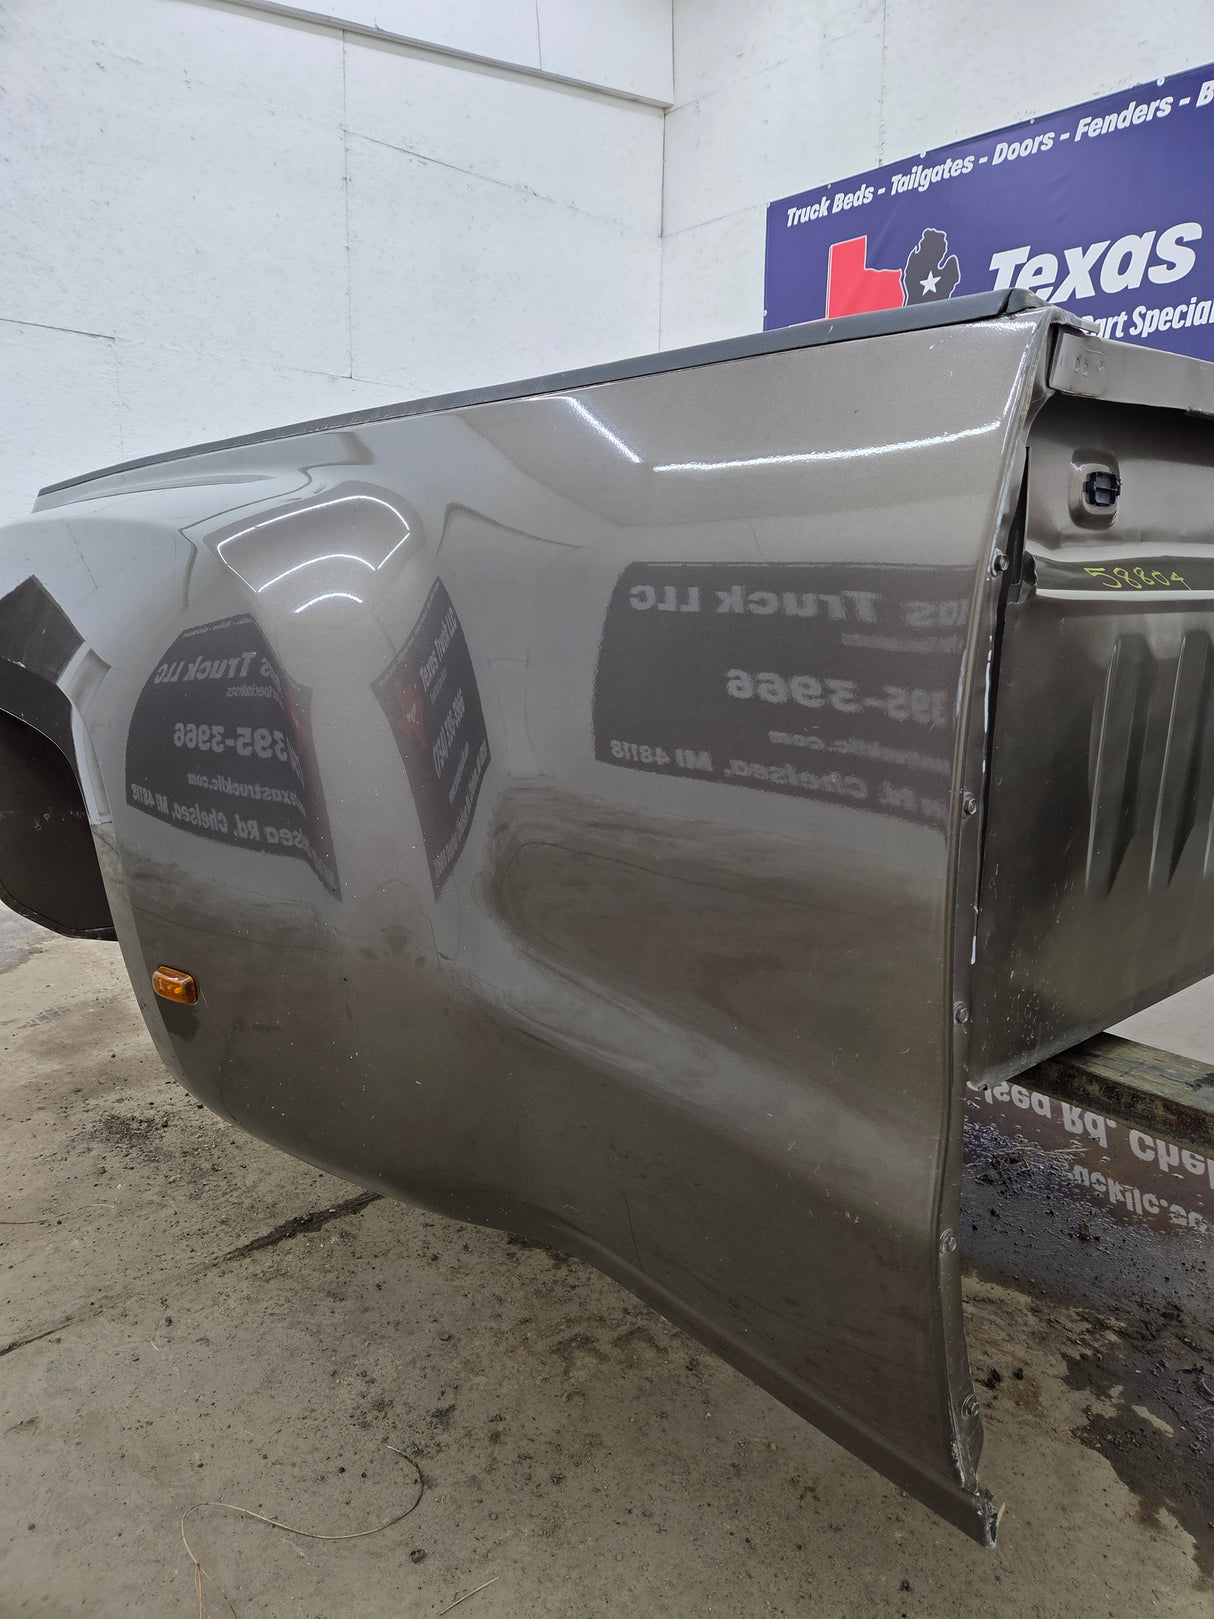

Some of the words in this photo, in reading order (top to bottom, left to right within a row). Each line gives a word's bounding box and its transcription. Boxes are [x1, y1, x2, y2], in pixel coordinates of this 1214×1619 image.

[787, 196, 830, 227] Truck
[832, 184, 874, 214] Beds
[891, 155, 975, 196] Tailgates
[992, 130, 1055, 166] Doors
[1074, 96, 1174, 142] Fenders
[1195, 79, 1214, 108] B
[989, 222, 1203, 304] Texas
[1129, 297, 1214, 338] Specia
[1083, 566, 1192, 591] 58804
